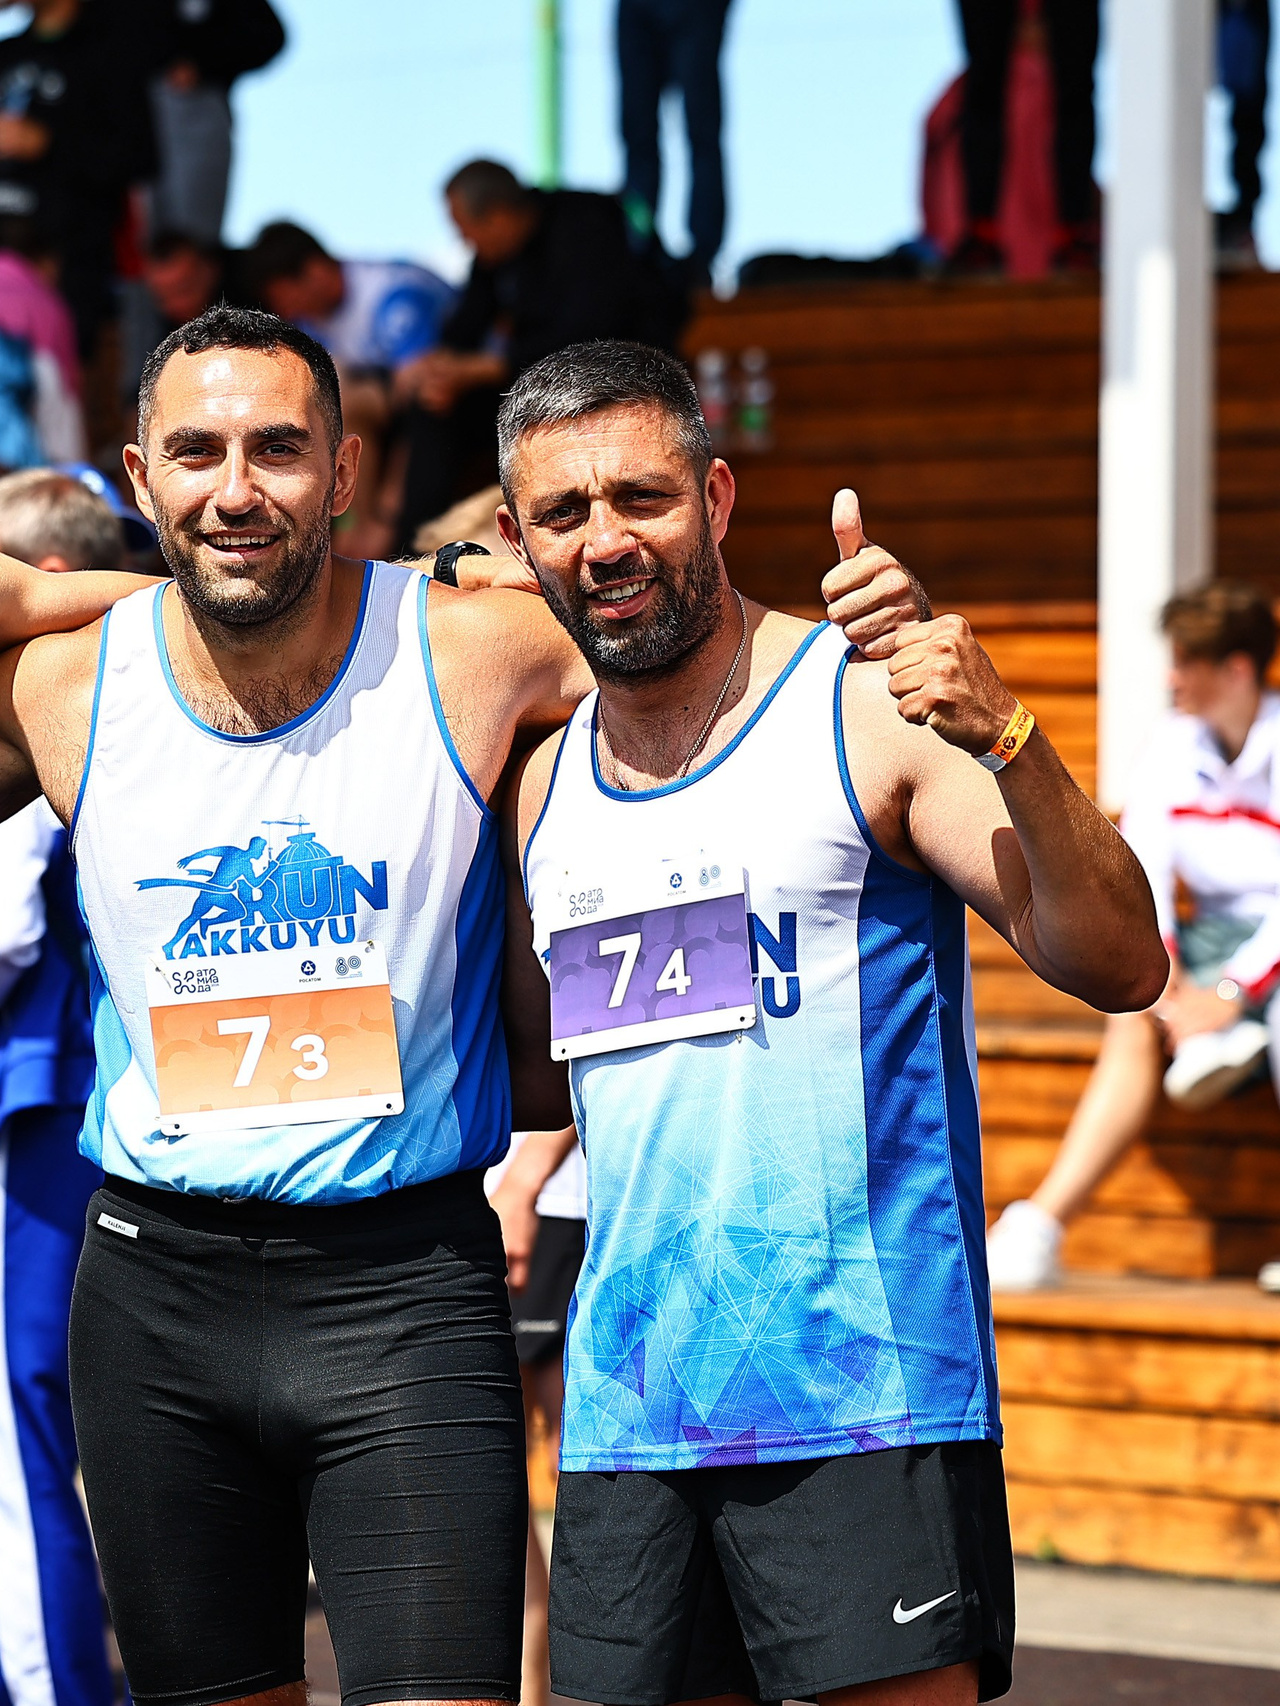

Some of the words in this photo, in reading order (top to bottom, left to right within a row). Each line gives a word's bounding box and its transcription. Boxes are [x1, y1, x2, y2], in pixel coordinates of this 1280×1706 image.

[239, 860, 389, 927] RUN
[179, 916, 357, 959] AKKUYU
[598, 932, 642, 1009] 7
[656, 947, 692, 996] 4
[217, 1015, 272, 1088] 7
[290, 1033, 330, 1081] 3
